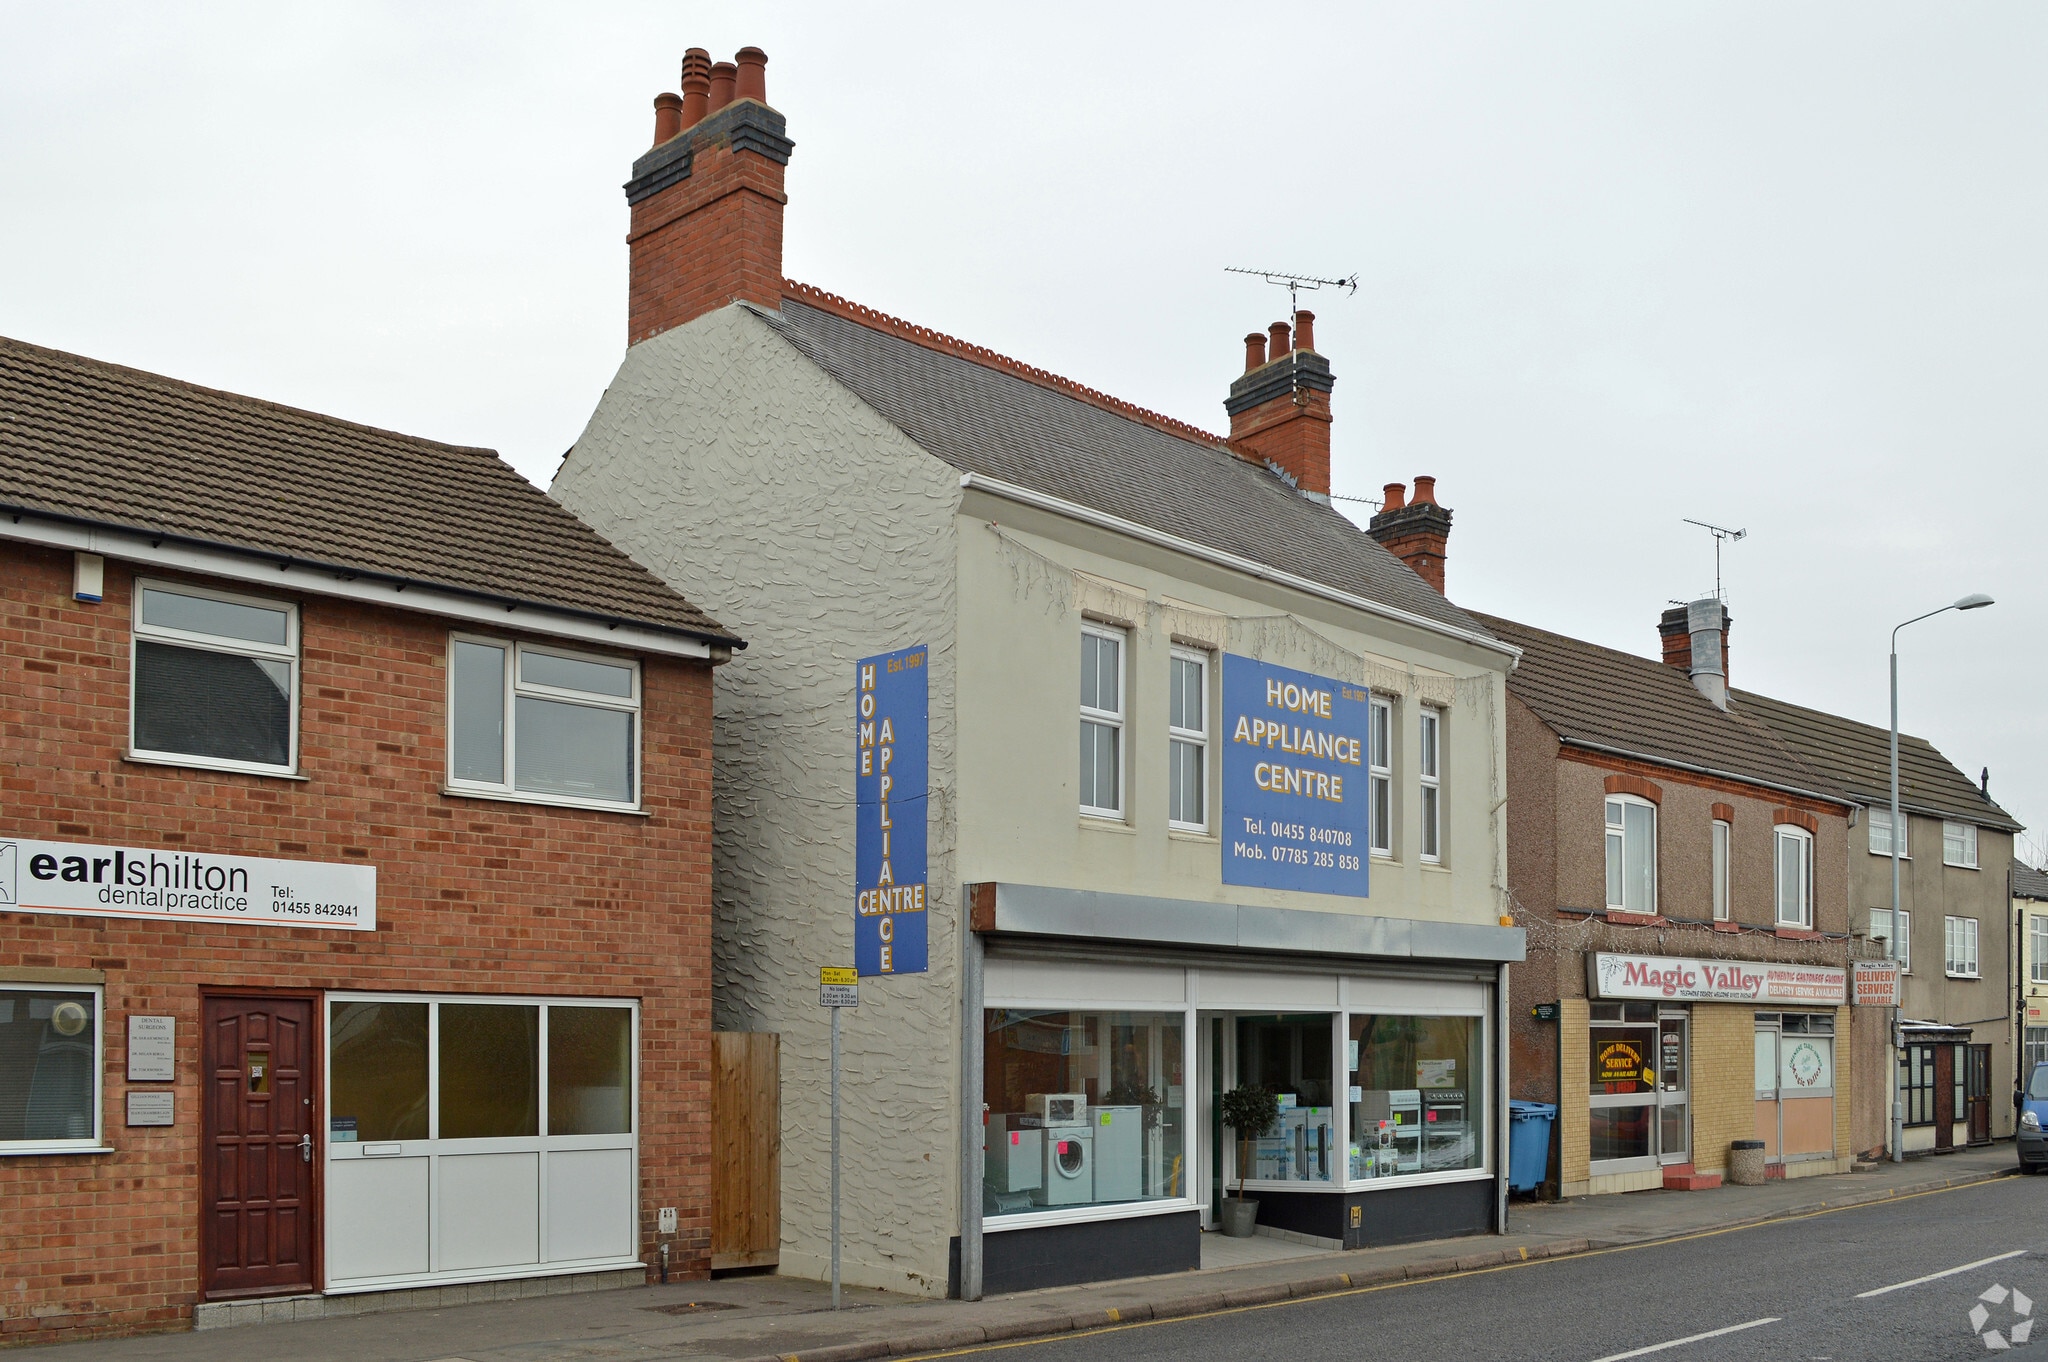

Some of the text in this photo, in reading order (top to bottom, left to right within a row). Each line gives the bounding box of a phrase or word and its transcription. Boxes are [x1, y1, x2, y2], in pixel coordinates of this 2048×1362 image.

[1266, 678, 1333, 719] HOME
[860, 663, 876, 776] HOME
[1233, 715, 1361, 766] APPLIANCE
[1254, 762, 1343, 803] CENTRE
[1243, 817, 1352, 847] Tel. 01455 840708
[1234, 841, 1360, 871] Mob. 07785 285 858
[271, 885, 294, 899] Tel:
[858, 884, 925, 916] CENTRE
[272, 900, 358, 917] 01455 842941
[1622, 961, 1764, 999] Magic Valley
[1767, 970, 1844, 984] AUTHENTIC CANTONESE CUISINE
[1855, 971, 1897, 982] DELIVERY
[1769, 985, 1843, 998] DELIVERY SERVICE AVAILABLE
[1857, 983, 1894, 994] SERVICE
[1858, 996, 1892, 1004] AVAILABLE
[1600, 1044, 1616, 1062] HOME
[1615, 1043, 1640, 1064] DELIVERY
[1606, 1058, 1633, 1068] SERVICE
